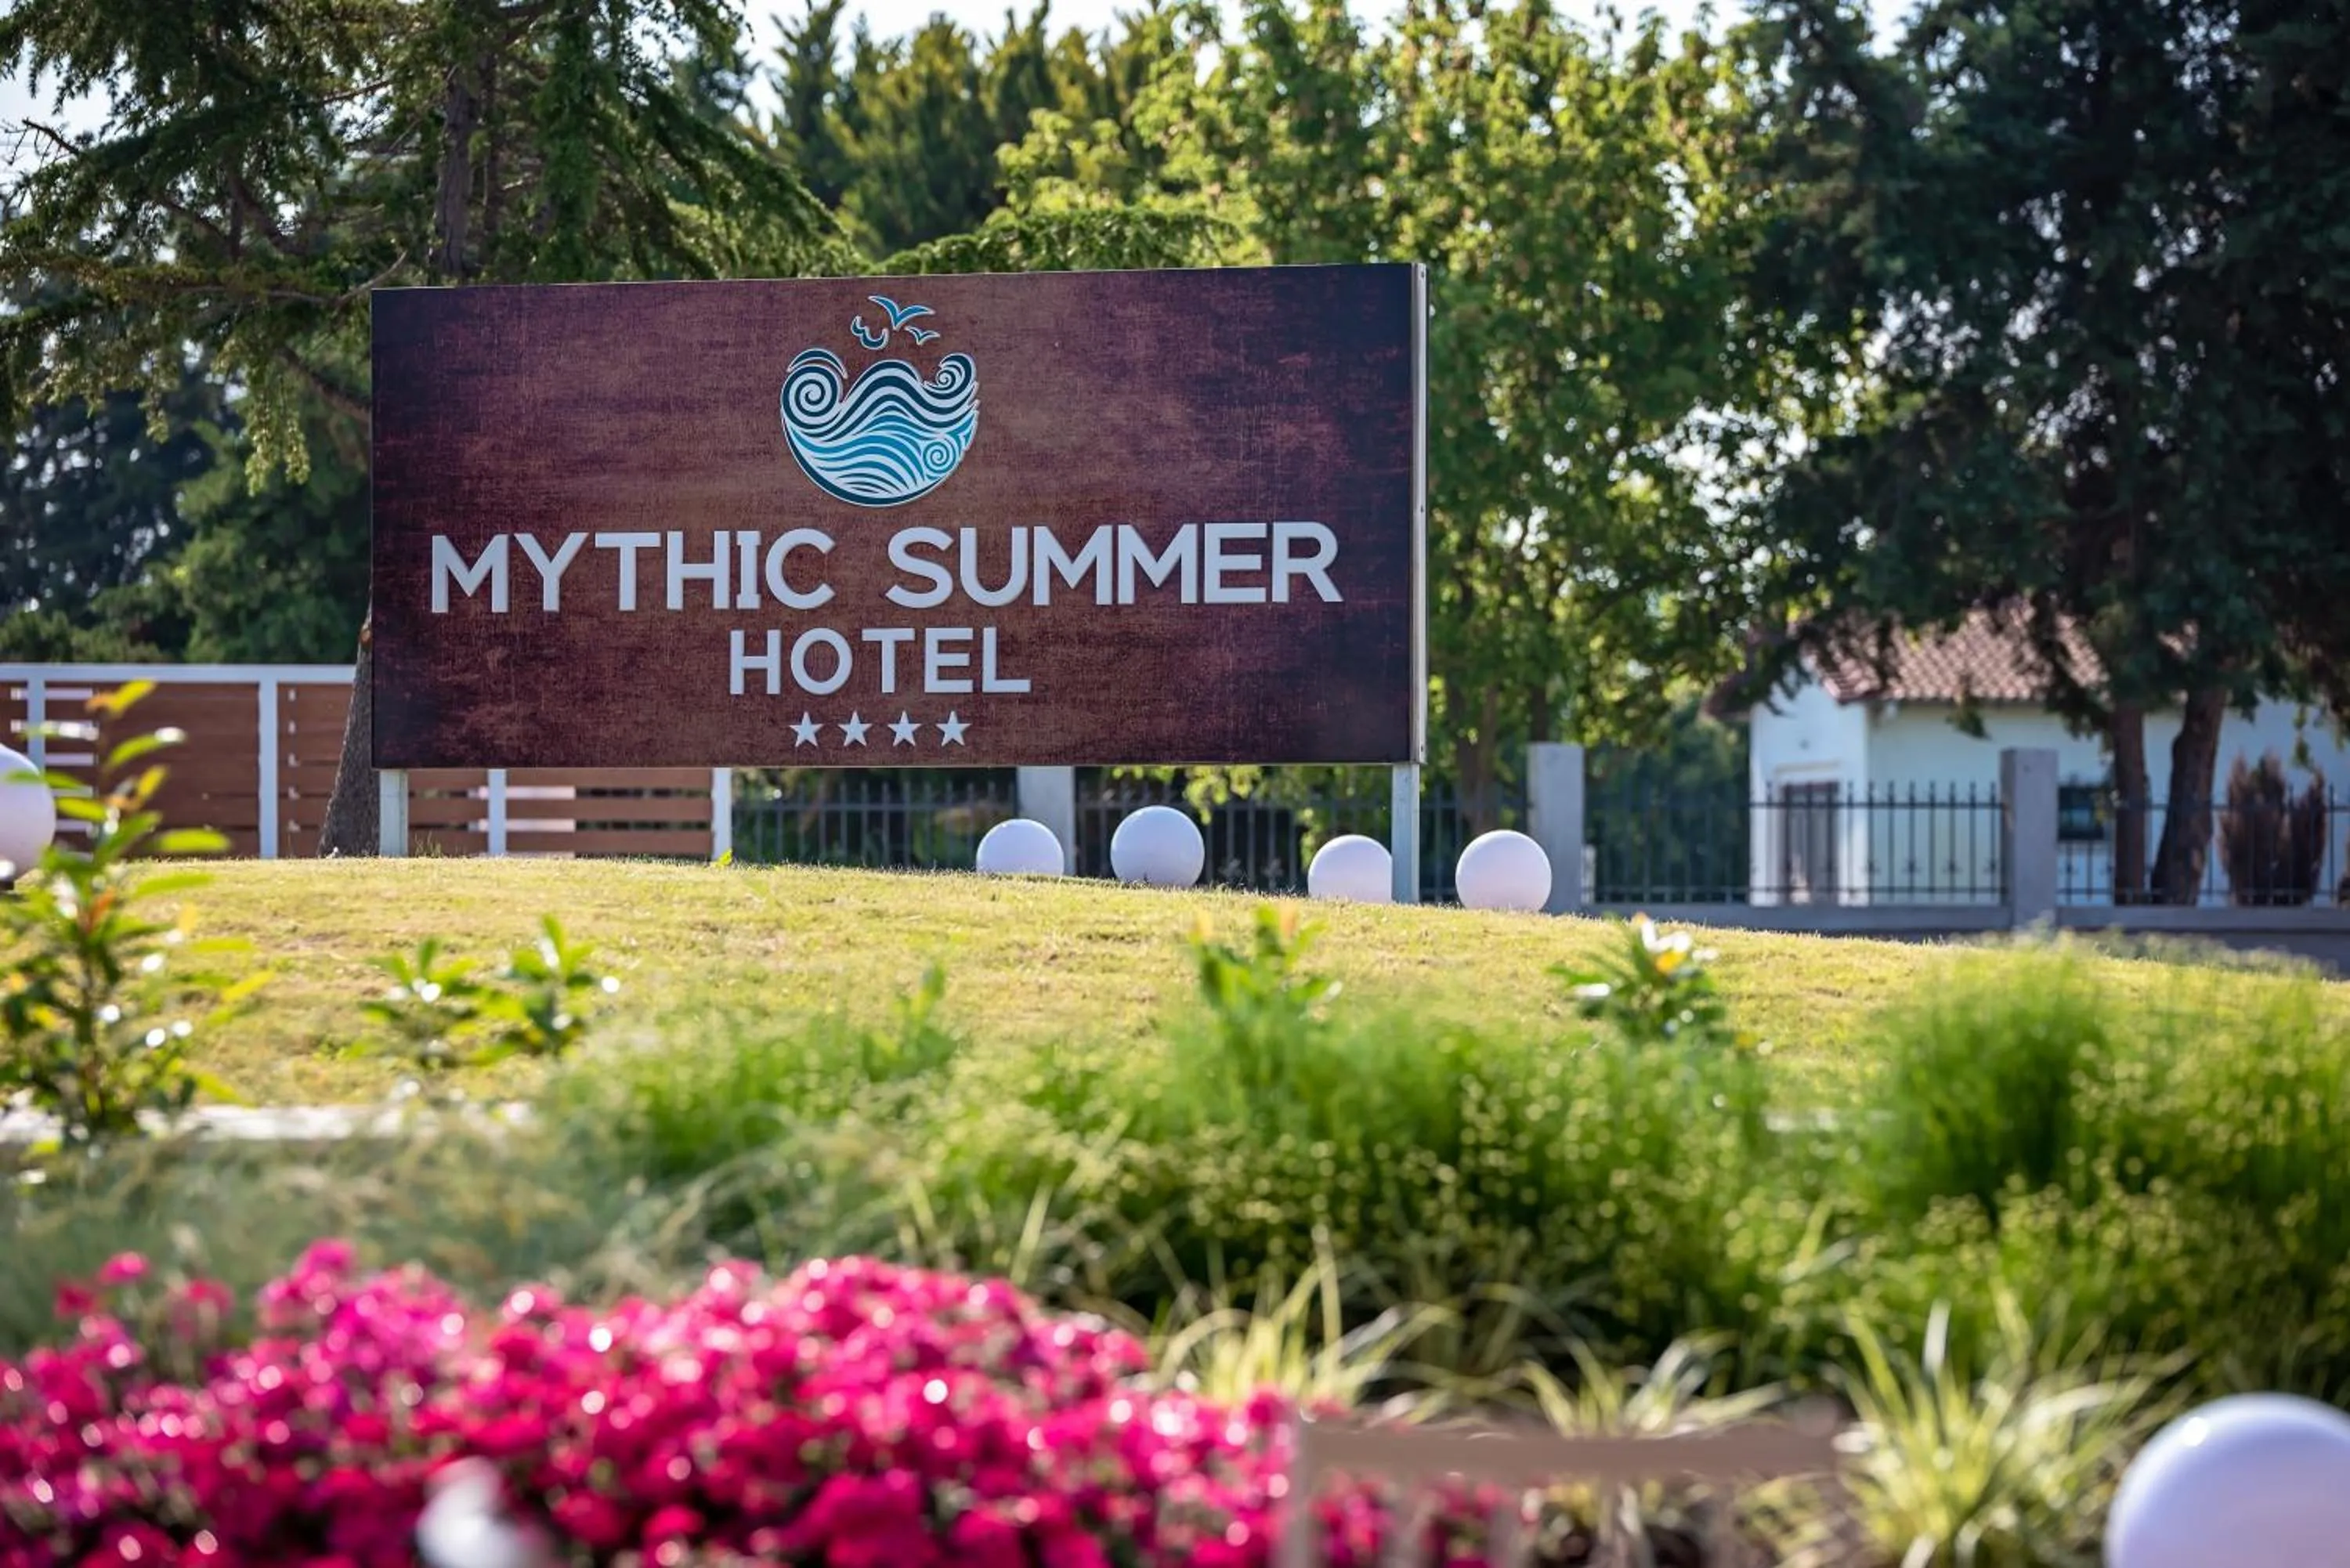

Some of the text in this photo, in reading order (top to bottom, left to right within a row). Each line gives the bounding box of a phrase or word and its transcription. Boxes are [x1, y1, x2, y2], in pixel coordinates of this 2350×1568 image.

[432, 522, 1343, 612] MYTHIC SUMMER
[730, 627, 1030, 694] HOTEL
